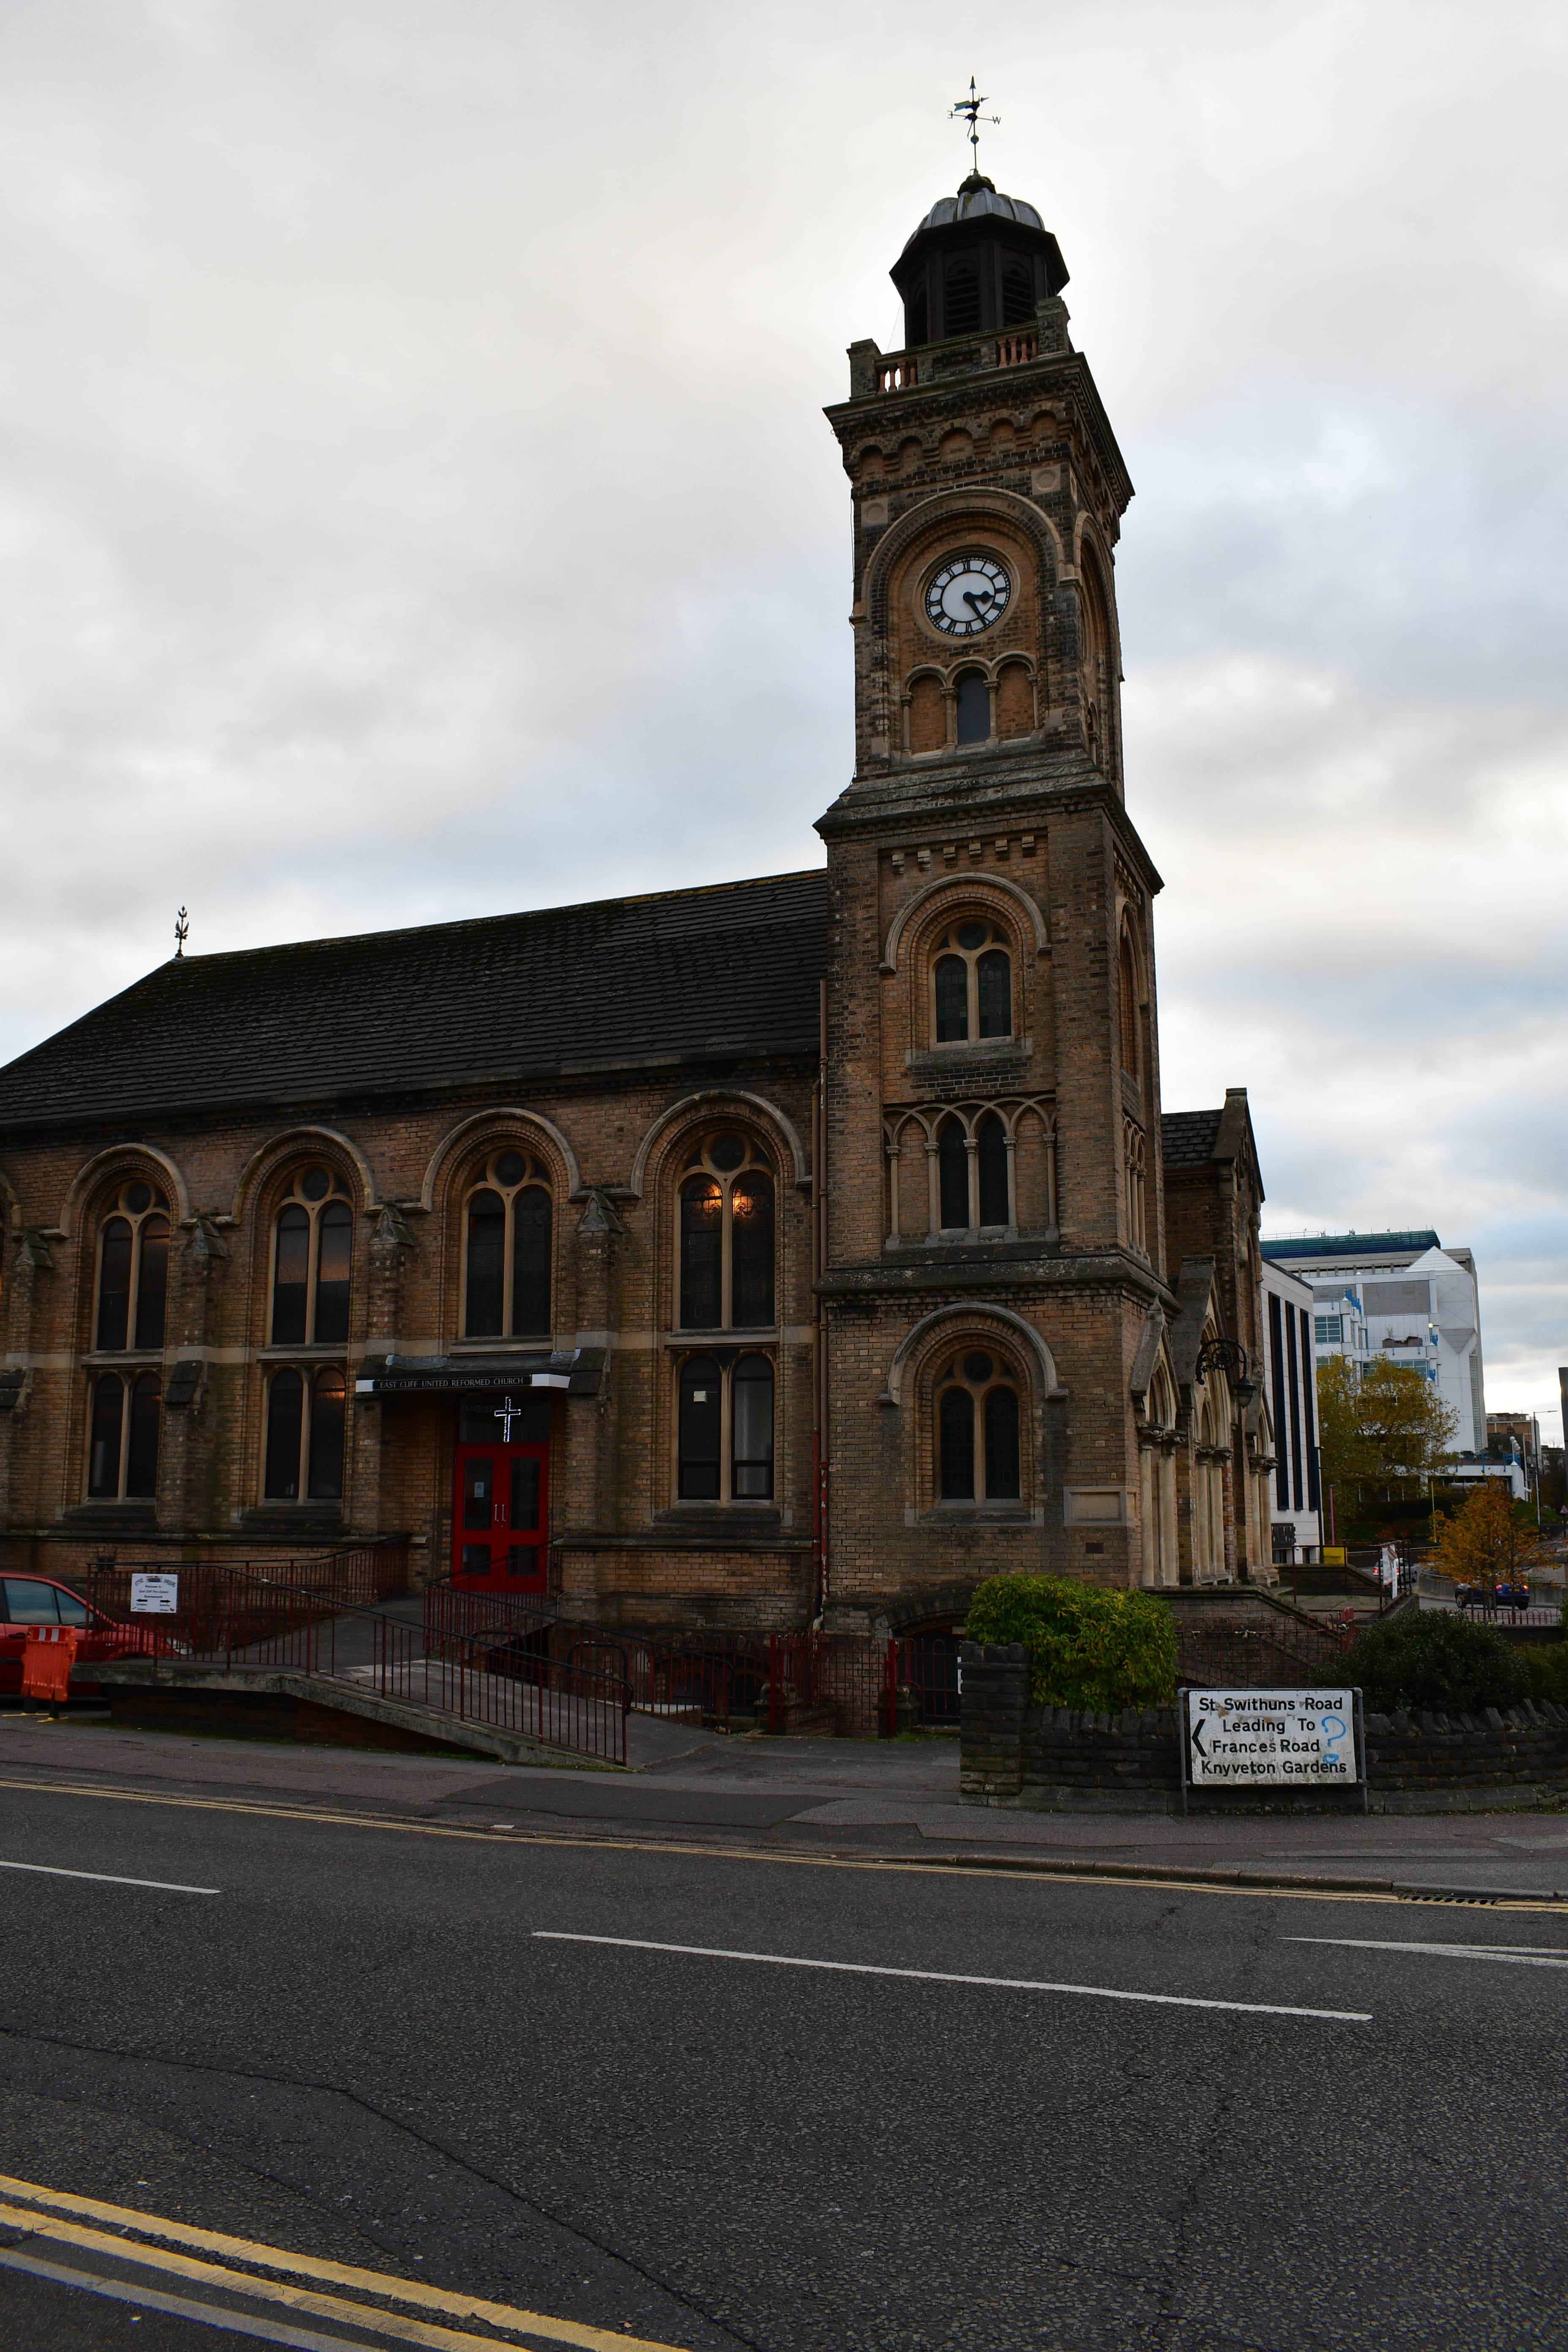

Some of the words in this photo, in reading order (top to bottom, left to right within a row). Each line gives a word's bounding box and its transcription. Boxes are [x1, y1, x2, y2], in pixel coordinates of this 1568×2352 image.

[1225, 1698, 1295, 1710] Swithuns
[1305, 1697, 1342, 1710] Road
[1223, 1719, 1285, 1734] Leading
[1298, 1718, 1315, 1731] To
[1213, 1740, 1276, 1753] Frances
[1280, 1739, 1320, 1752] Road
[1201, 1760, 1275, 1777] Knyveton
[1282, 1760, 1347, 1773] Gardens
